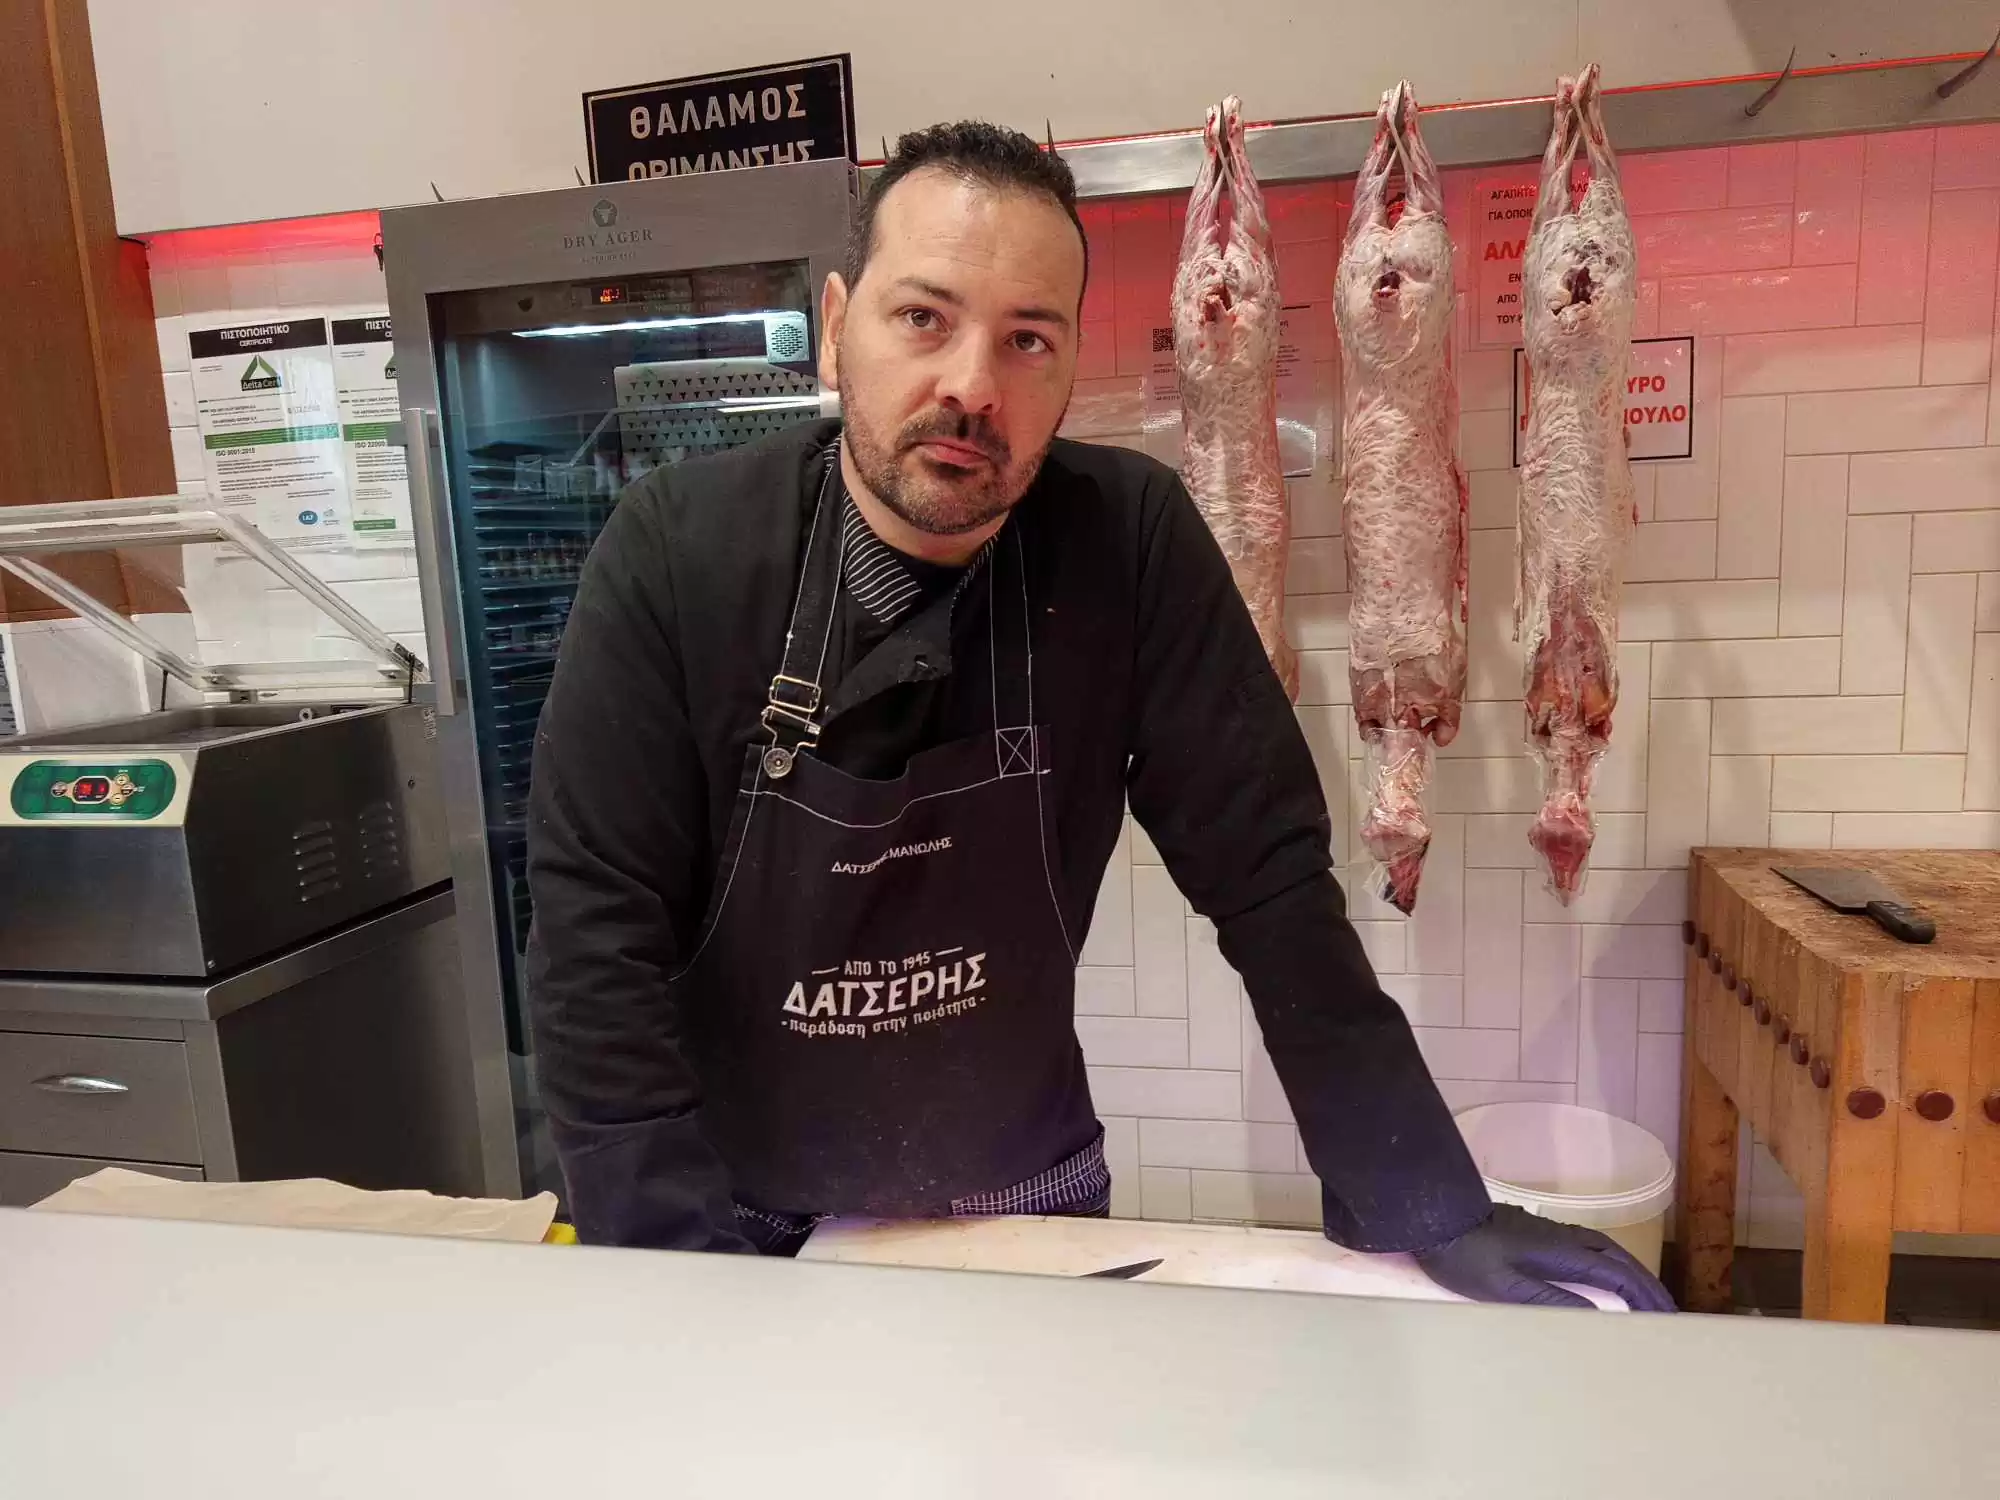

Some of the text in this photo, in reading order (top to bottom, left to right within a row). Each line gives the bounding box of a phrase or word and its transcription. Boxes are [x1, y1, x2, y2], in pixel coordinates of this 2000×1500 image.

[630, 83, 807, 140] ΘΑΛΑΜΟΣ
[563, 228, 653, 249] DRY AGER
[1497, 294, 1518, 304] ΑΠΟ
[220, 324, 290, 341] ΠΙΣΤΟΠΟΙΗΤΙΚΟ
[239, 337, 273, 348] CERTIFICATE
[1626, 375, 1667, 394] ΥΡΟ
[888, 836, 953, 859] ΜΑΝΩΛΗΣ
[844, 951, 931, 977] ΑΠΟ ΤΟ 1945
[782, 952, 987, 1017] ΔΑΤΣΕΡΗΣ
[872, 1017, 907, 1034] στην
[913, 996, 977, 1025] ποιότητα
